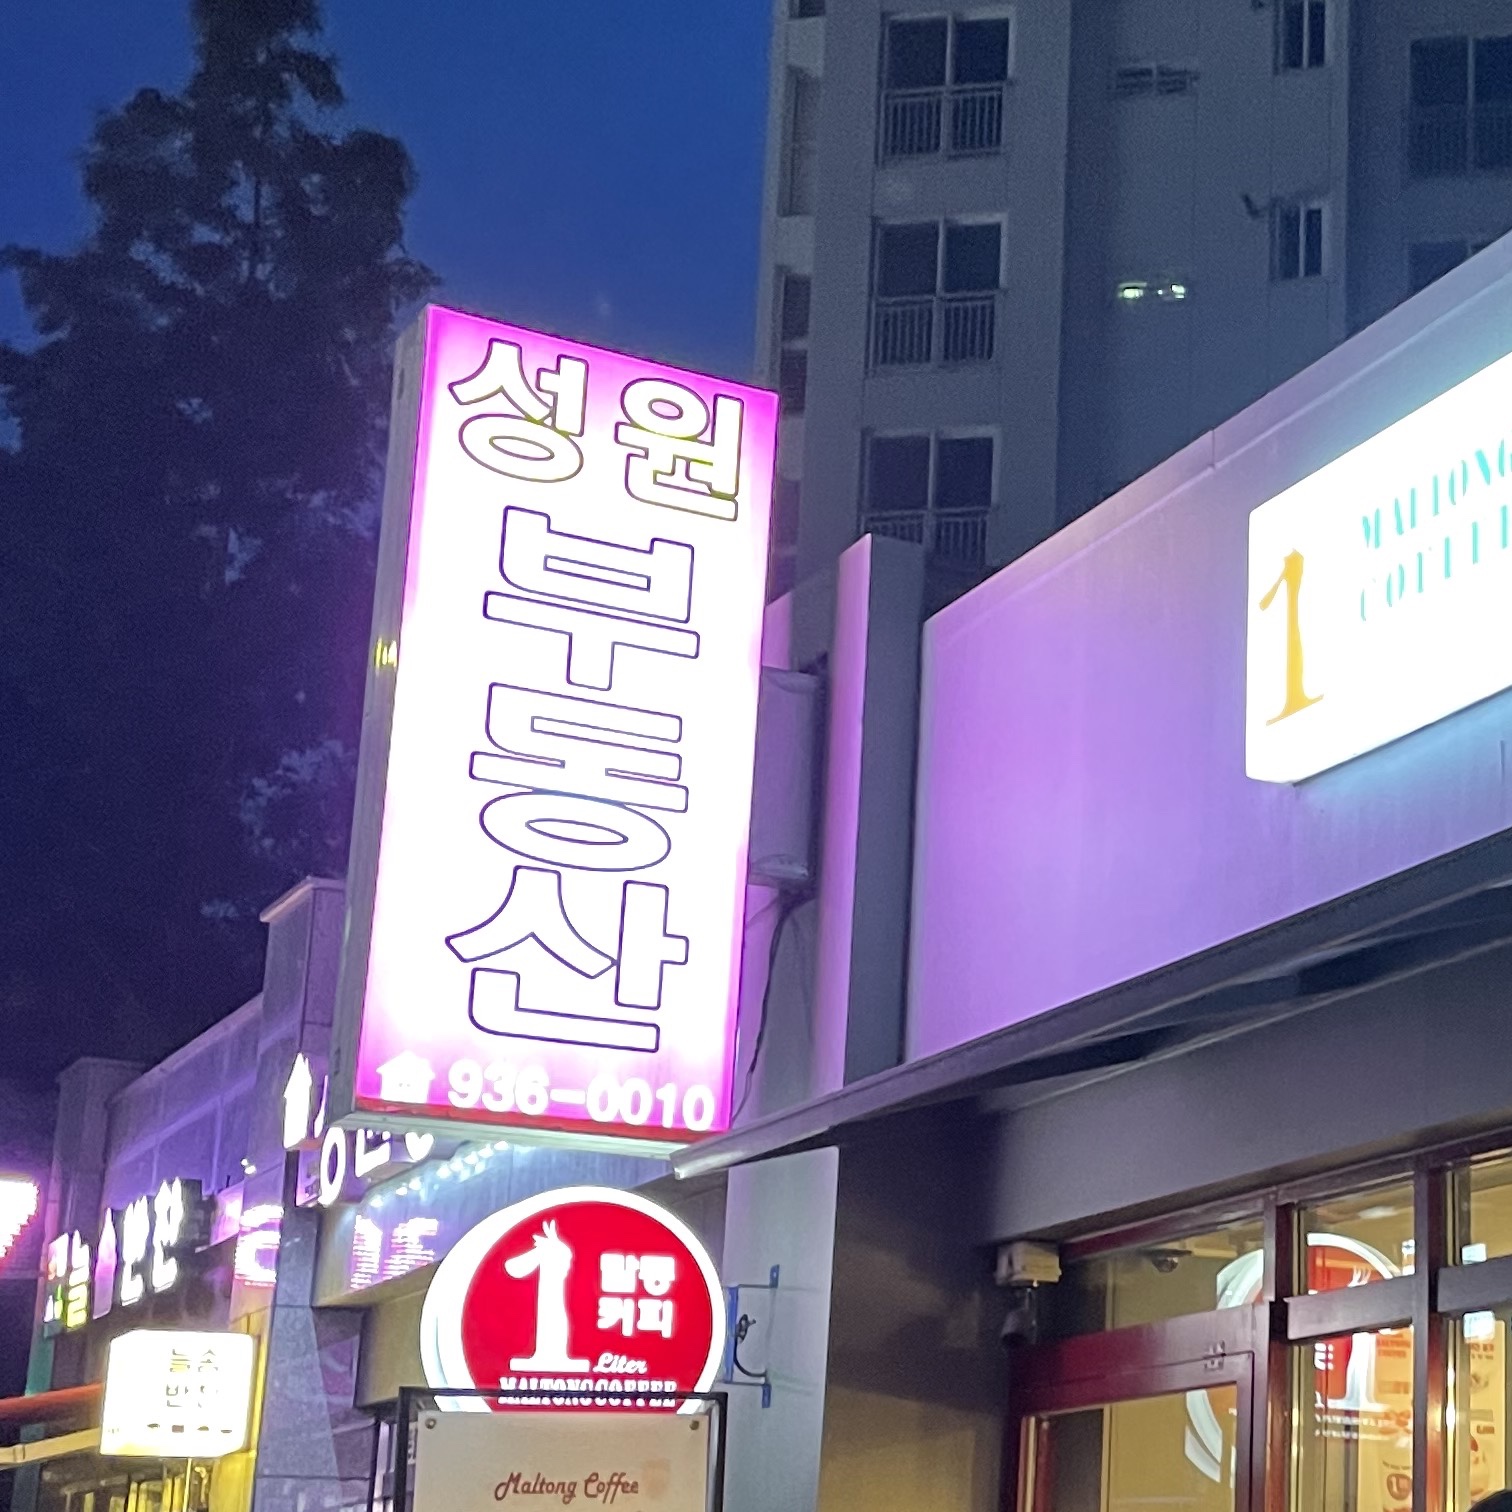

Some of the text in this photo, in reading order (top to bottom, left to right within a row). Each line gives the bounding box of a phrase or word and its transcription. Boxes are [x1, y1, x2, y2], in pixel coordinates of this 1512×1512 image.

[448, 338, 744, 521] 성원
[445, 505, 700, 1052] 부동산
[447, 1058, 715, 1131] 936-0010
[597, 1296, 674, 1339] 커피
[592, 1352, 648, 1375] Liter
[494, 1472, 640, 1504] Maltong Coffee
